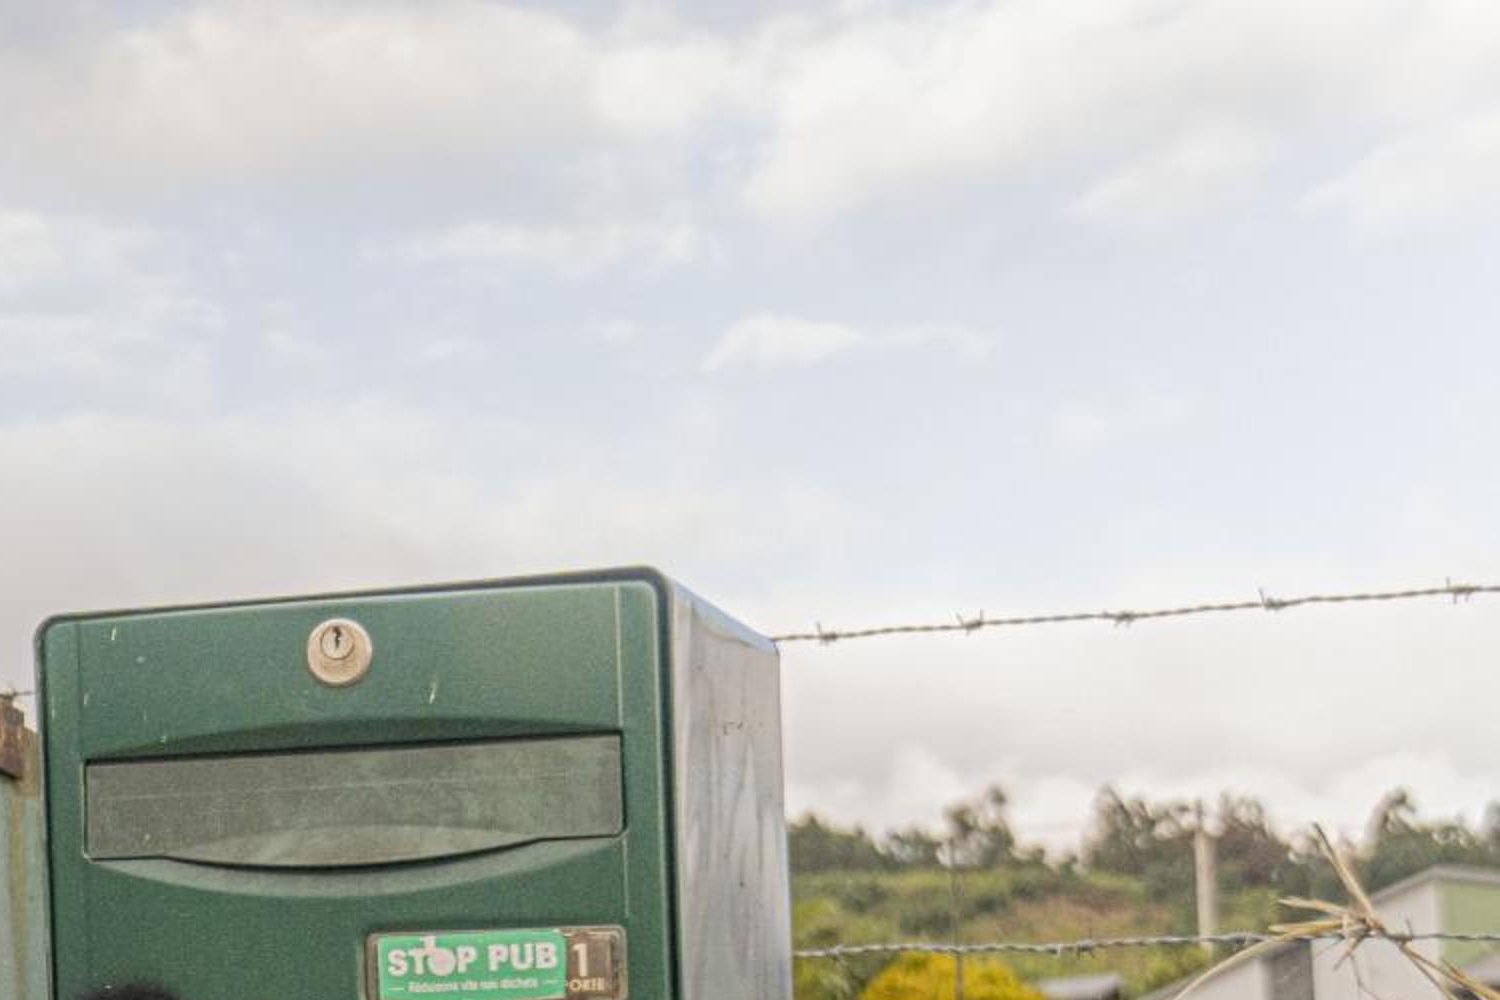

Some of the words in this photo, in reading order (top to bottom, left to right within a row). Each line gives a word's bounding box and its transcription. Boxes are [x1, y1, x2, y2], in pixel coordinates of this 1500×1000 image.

[387, 937, 477, 976] STOP
[487, 942, 557, 972] PUB
[572, 943, 588, 977] 1
